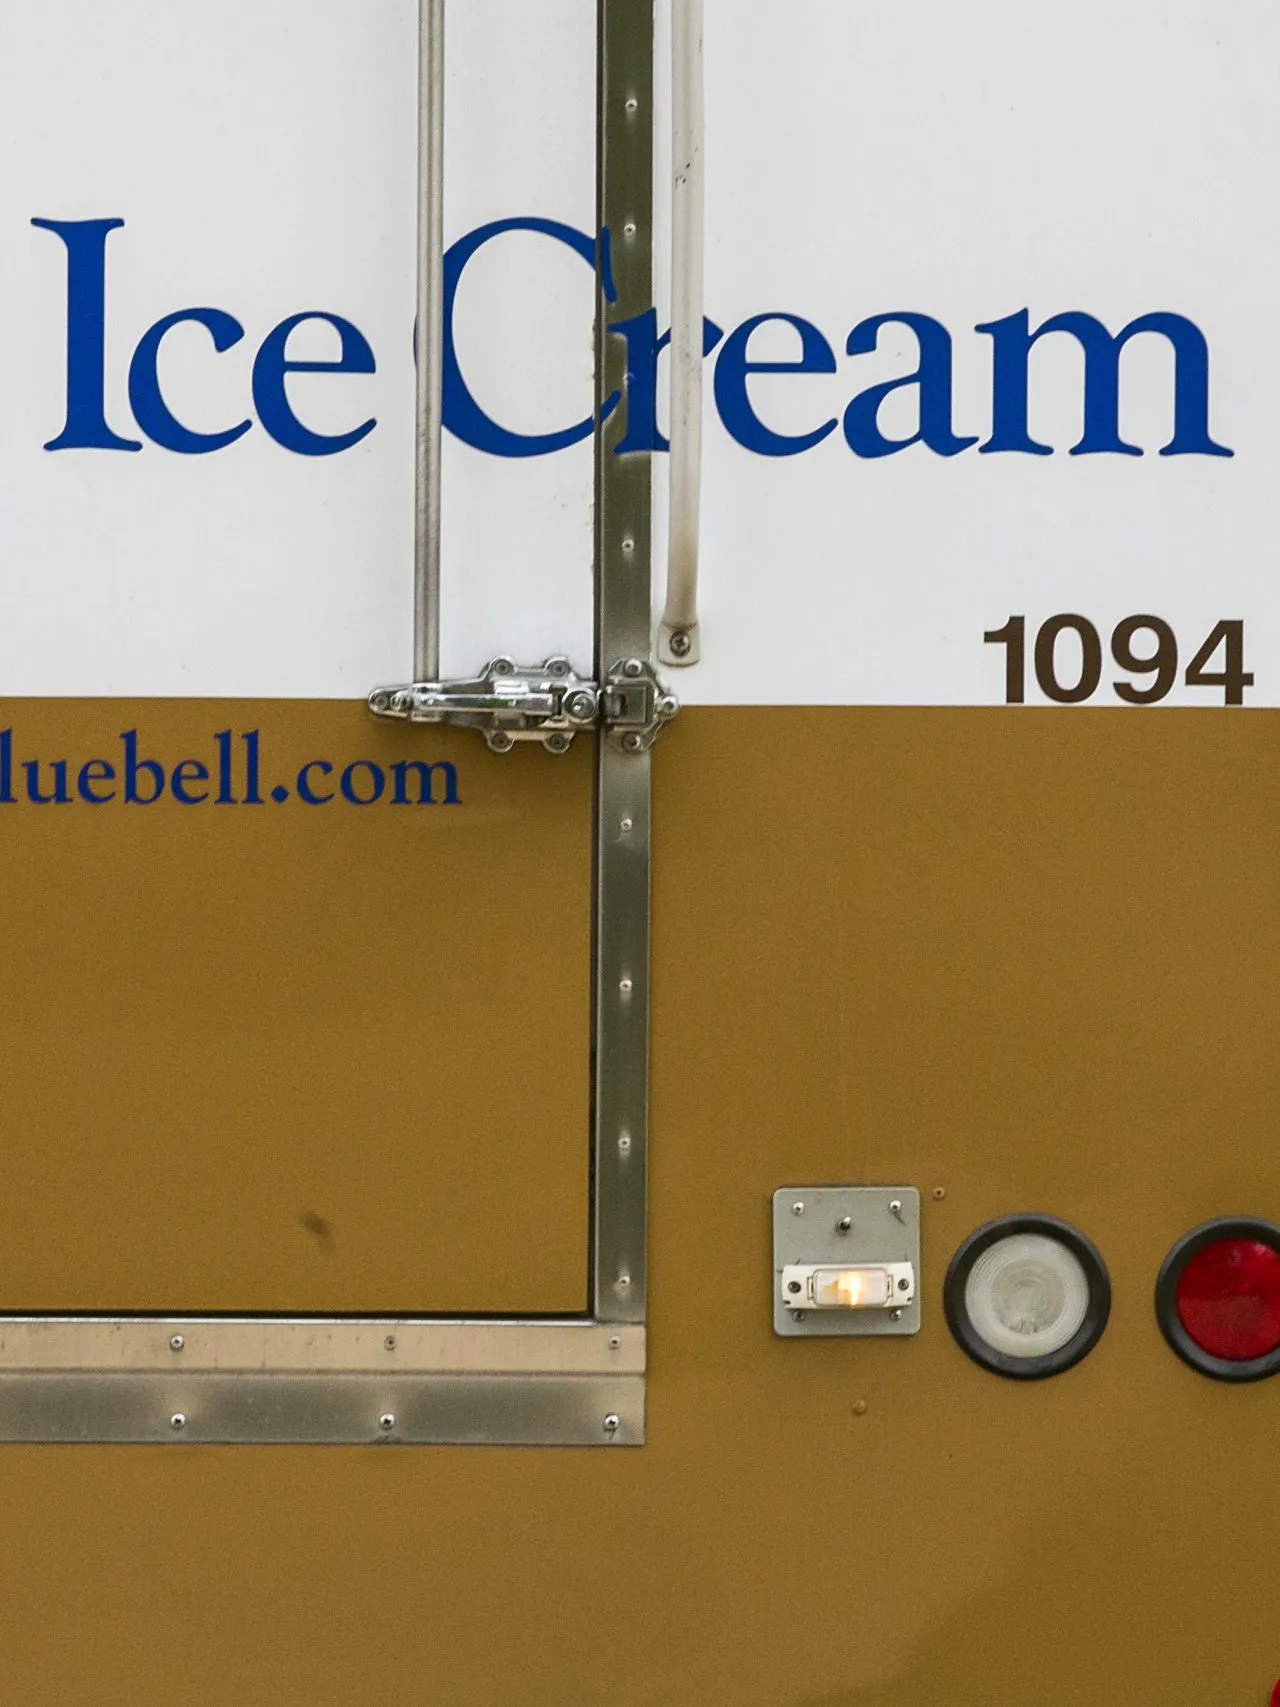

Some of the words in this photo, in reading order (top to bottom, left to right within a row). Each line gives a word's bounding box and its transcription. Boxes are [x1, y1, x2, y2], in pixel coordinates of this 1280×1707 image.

[31, 216, 377, 456] Ice
[414, 216, 1235, 458] Cream
[983, 613, 1255, 706] 1094
[0, 728, 464, 805] luebell.com
